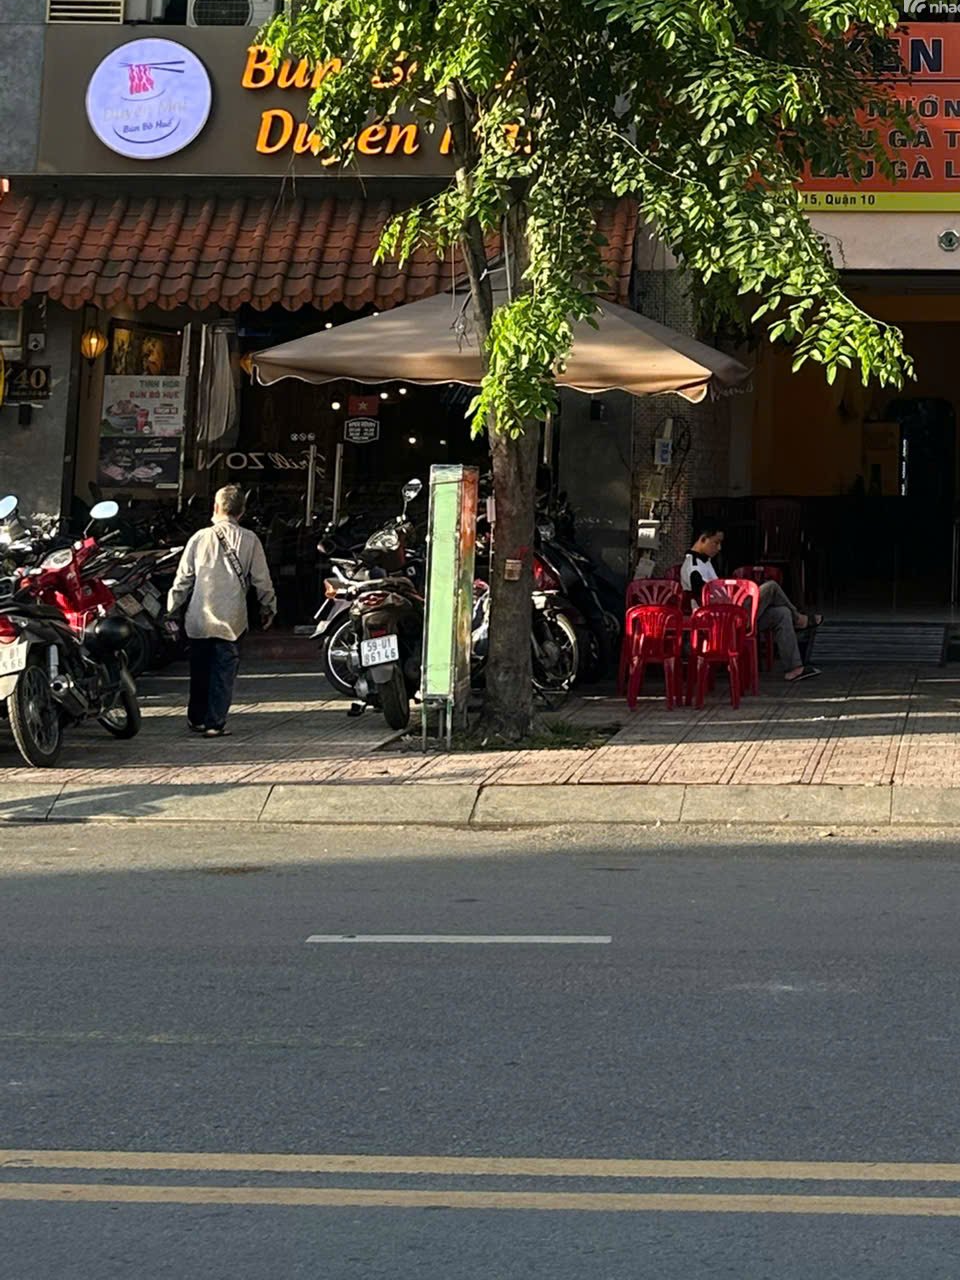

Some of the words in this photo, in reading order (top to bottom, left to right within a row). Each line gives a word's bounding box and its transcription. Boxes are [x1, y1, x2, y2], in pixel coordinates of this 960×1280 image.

[888, 122, 933, 149] GÀ
[825, 194, 857, 208] Quận
[862, 194, 876, 206] 10
